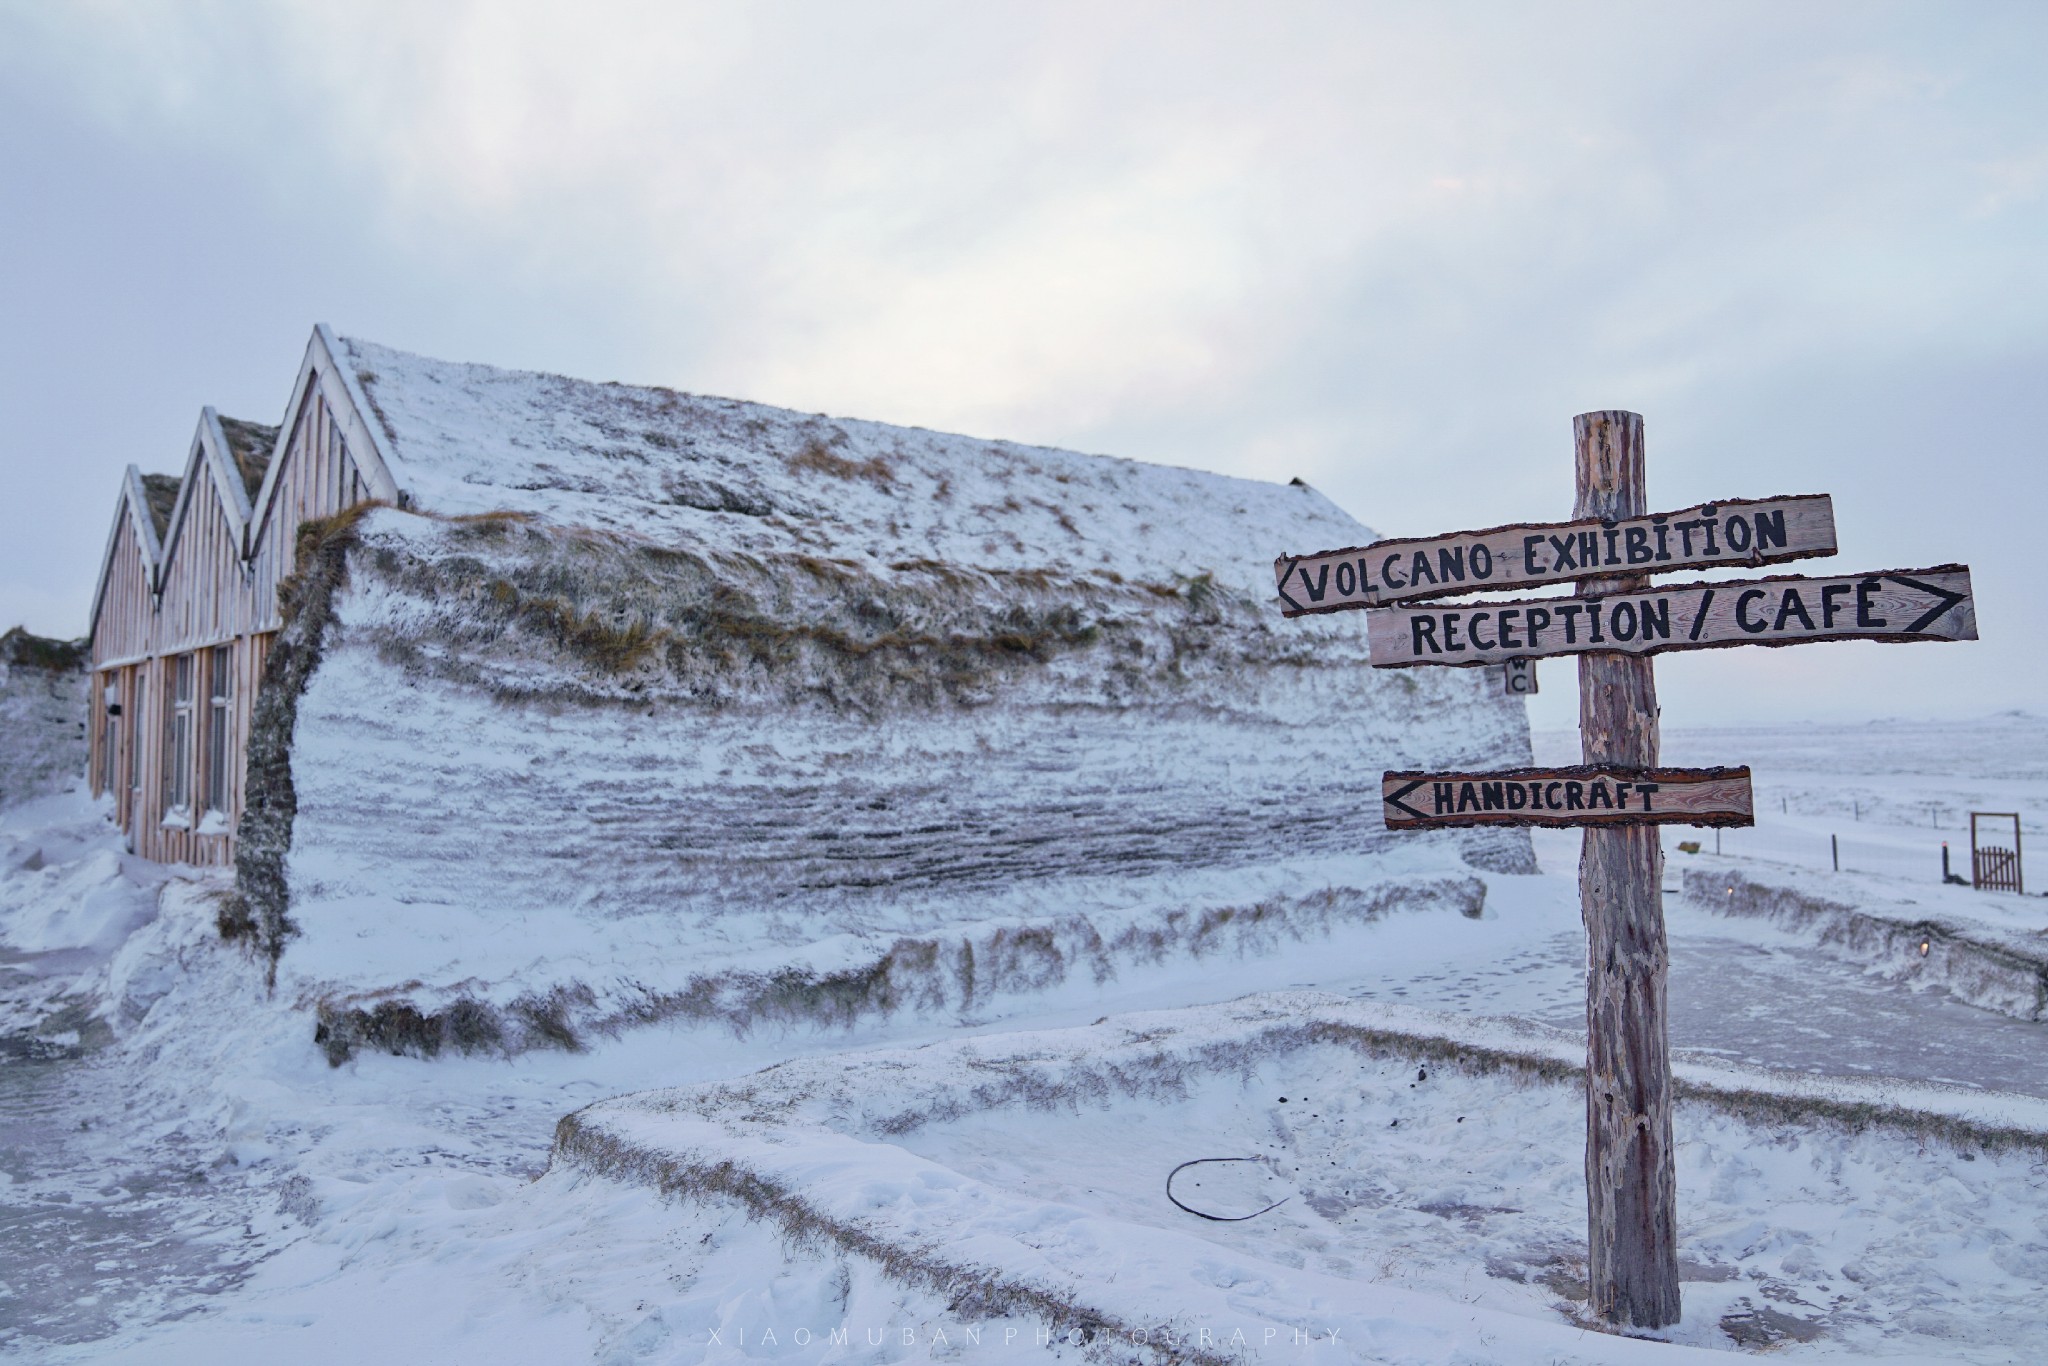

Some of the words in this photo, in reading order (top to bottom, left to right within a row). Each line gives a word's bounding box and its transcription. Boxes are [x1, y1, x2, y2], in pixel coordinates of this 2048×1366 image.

[1298, 543, 1493, 602] VOLCANO
[1410, 598, 1671, 656] RECEPTION
[1433, 781, 1659, 815] HANDICRAFT
